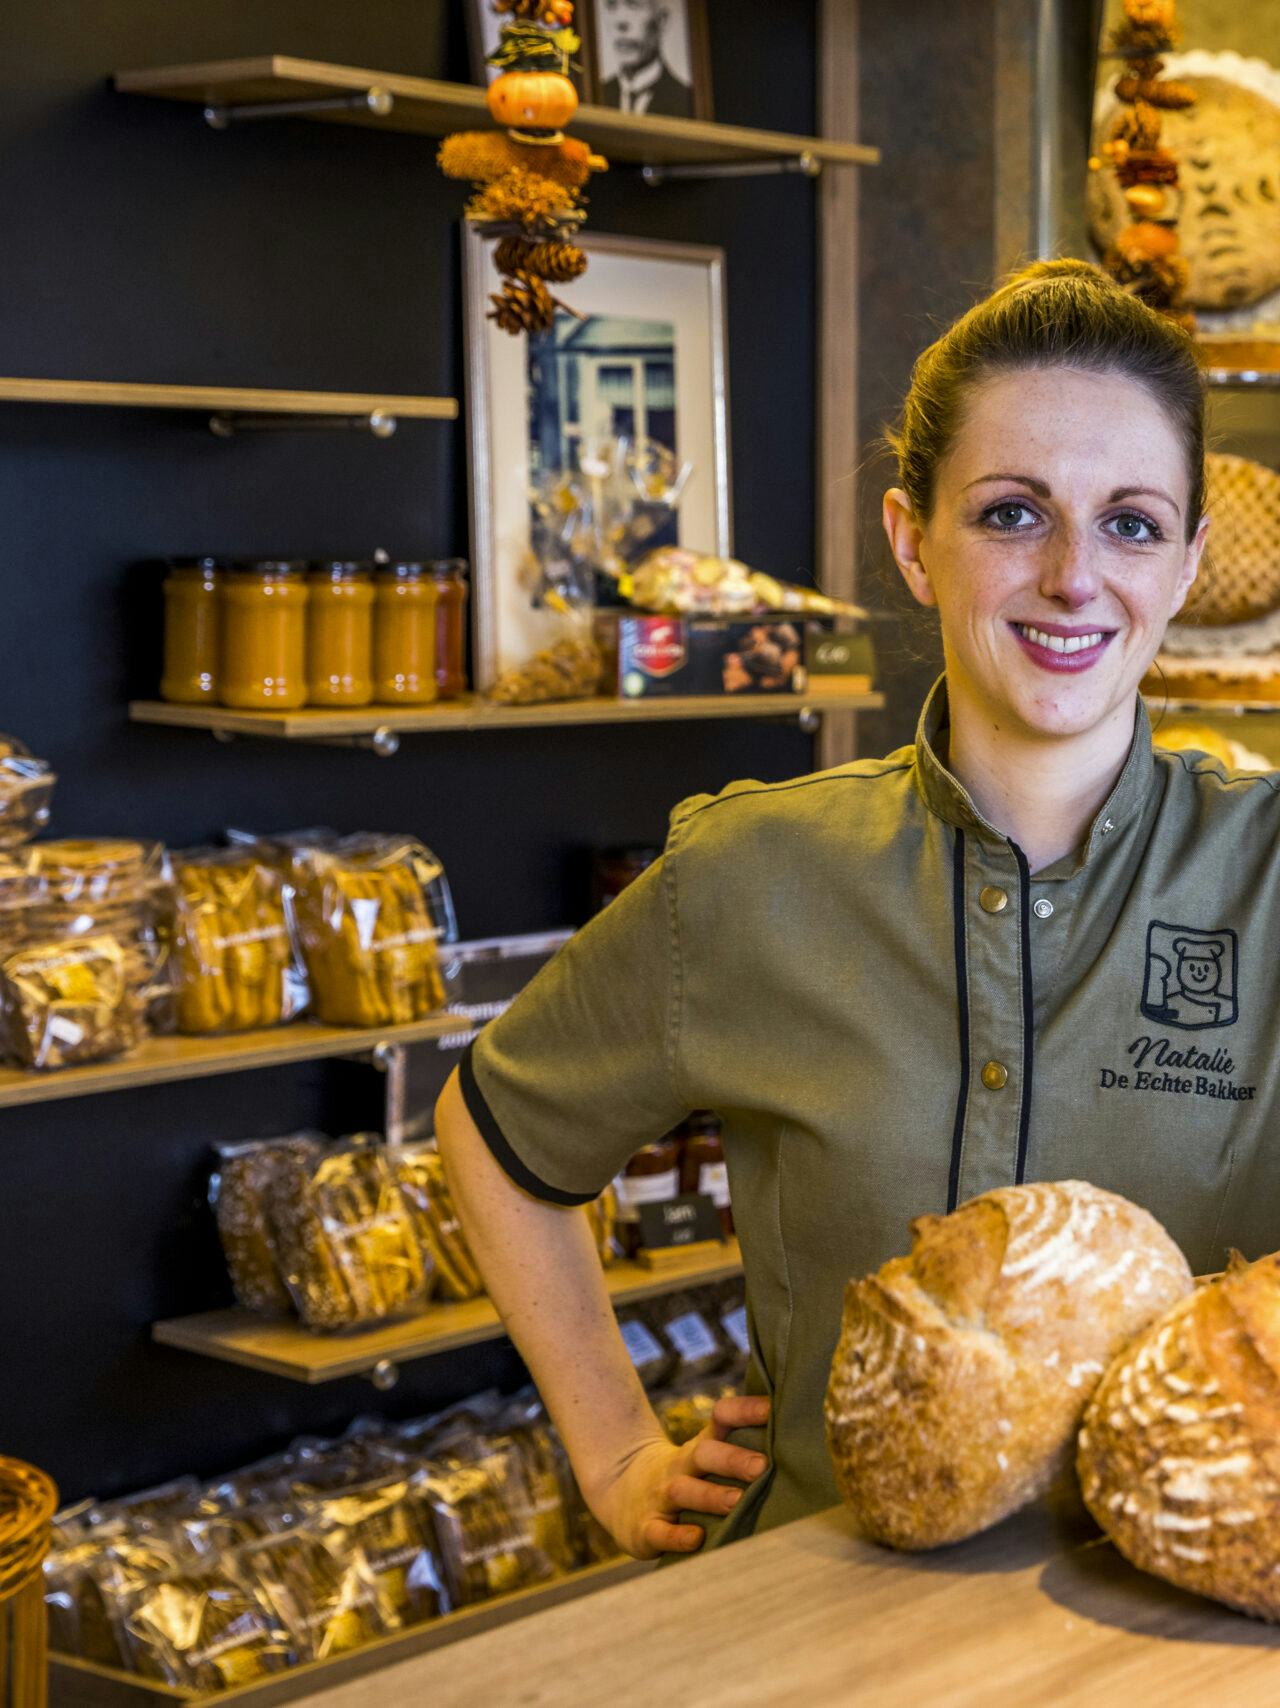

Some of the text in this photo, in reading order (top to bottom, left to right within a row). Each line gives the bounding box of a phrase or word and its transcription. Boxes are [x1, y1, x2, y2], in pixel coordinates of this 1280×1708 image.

[1128, 1037, 1235, 1074] Natalie
[1100, 1069, 1257, 1101] De Echte Bakker
